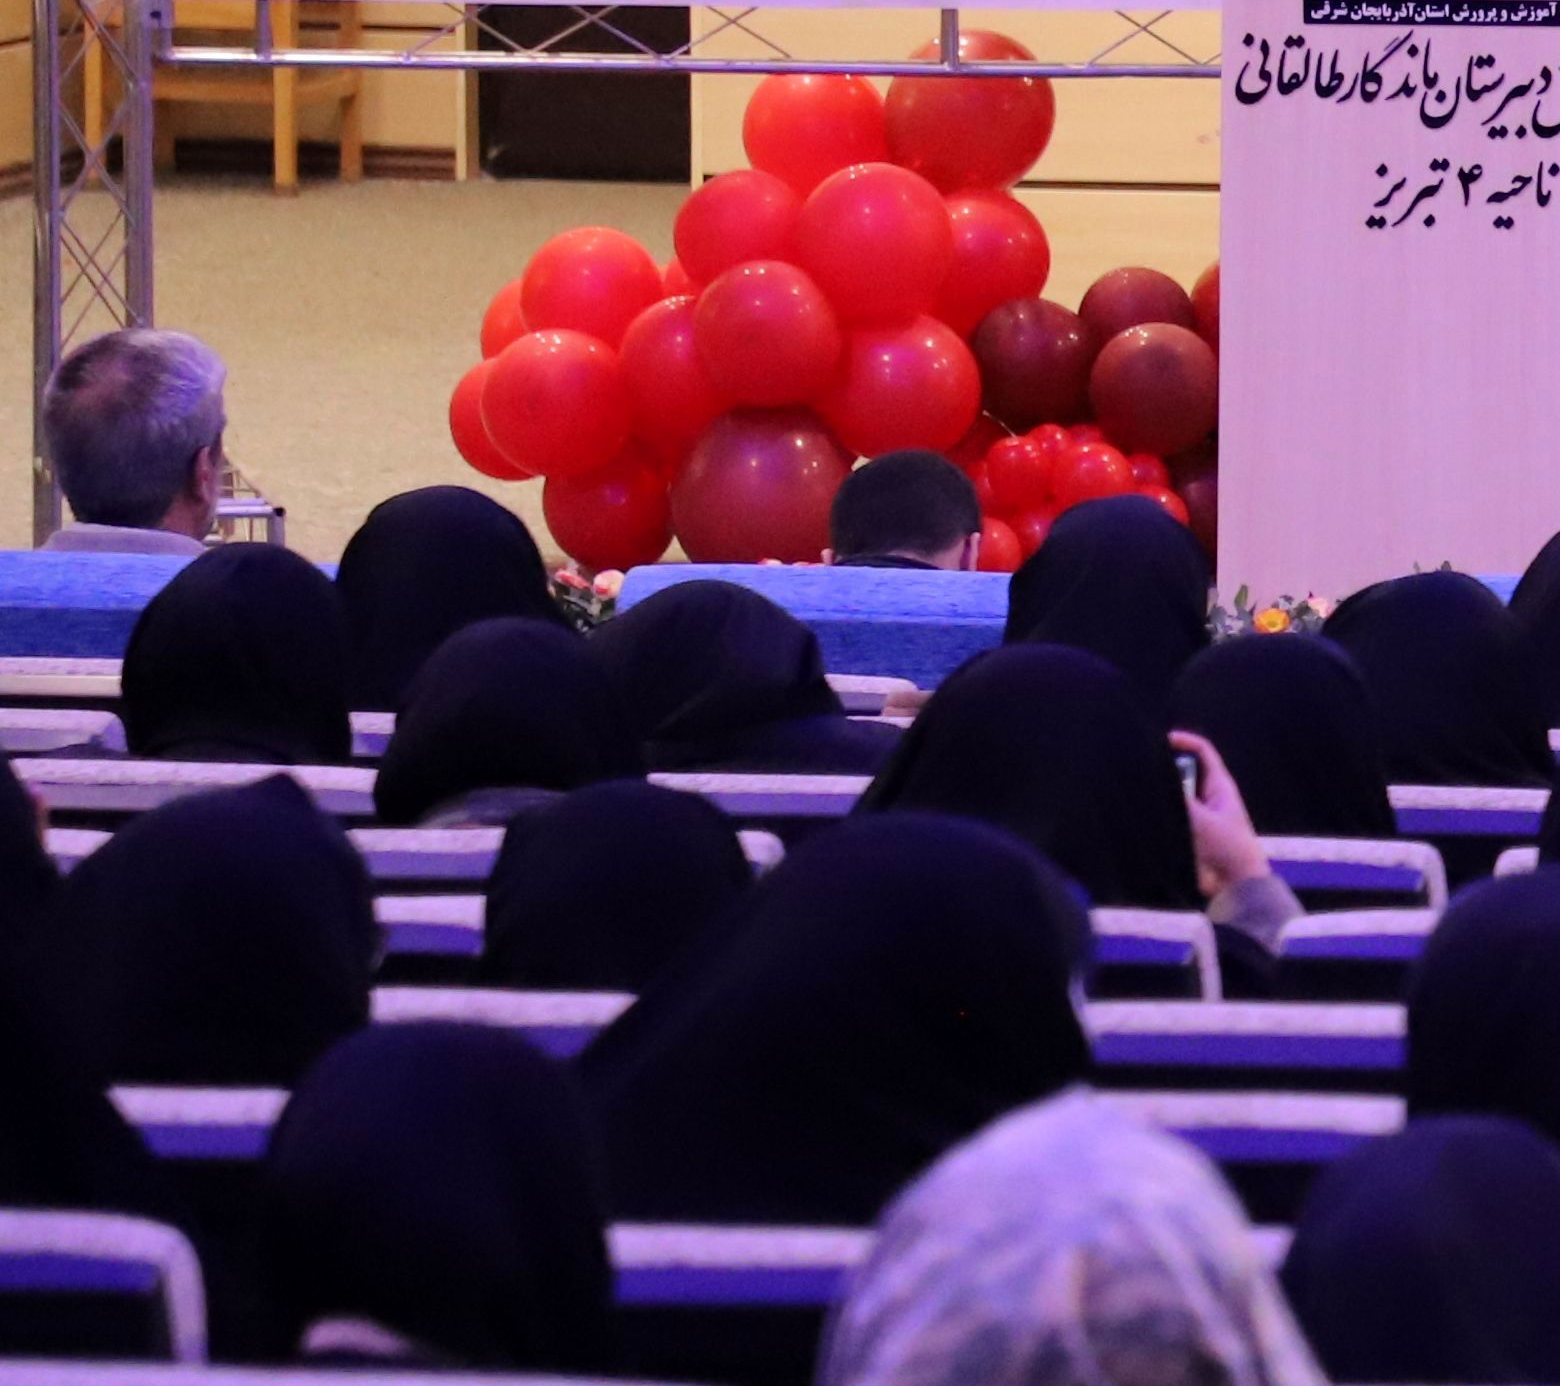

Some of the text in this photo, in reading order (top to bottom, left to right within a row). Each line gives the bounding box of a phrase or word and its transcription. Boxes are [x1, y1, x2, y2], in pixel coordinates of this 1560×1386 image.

[1310, 0, 1348, 20] شرقی
[1350, 1, 1416, 23] آذربایجان
[1414, 3, 1450, 23] استان
[1452, 3, 1498, 23] پرورش
[1500, 9, 1508, 22] و
[1510, 1, 1557, 22] آموزش
[1234, 32, 1346, 105] طالقانی
[1336, 29, 1440, 104] ماندگار
[1419, 53, 1553, 140] دبیرستان
[1365, 158, 1451, 230] تبریز
[1486, 160, 1560, 229] ناحیه
